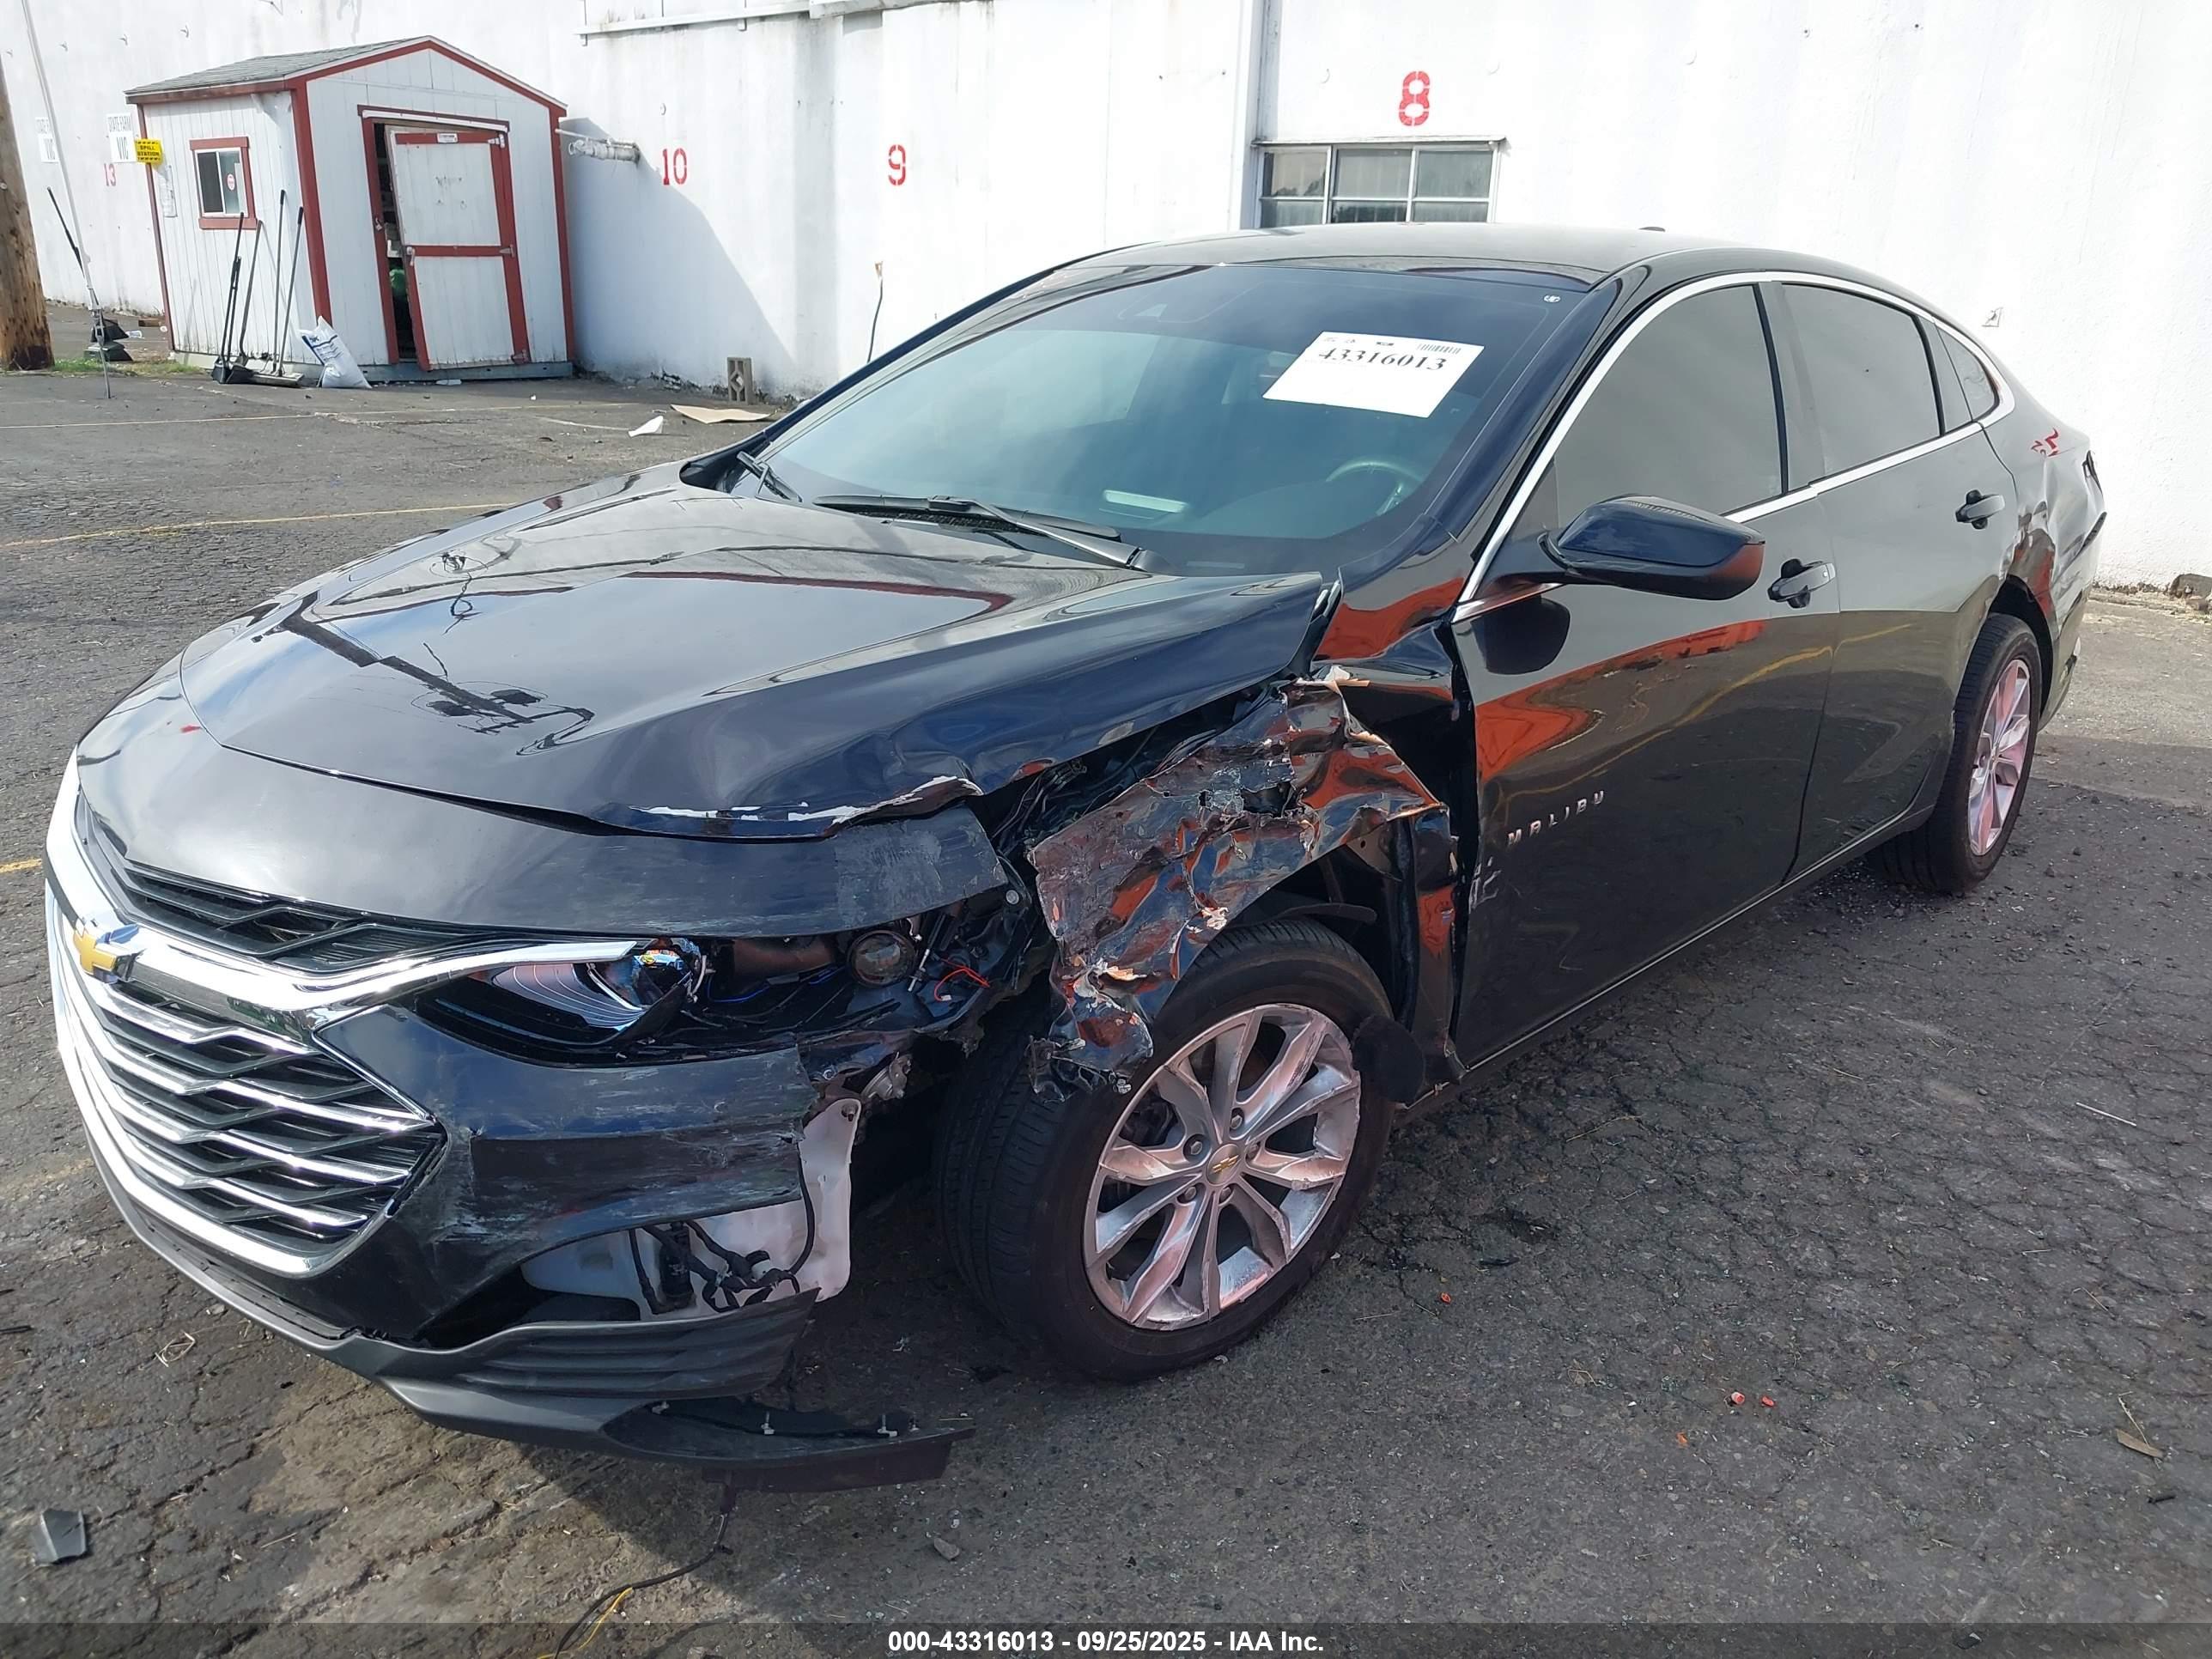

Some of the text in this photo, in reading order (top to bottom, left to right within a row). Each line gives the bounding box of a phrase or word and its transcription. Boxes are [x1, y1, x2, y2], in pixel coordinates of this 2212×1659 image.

[1399, 70, 1430, 126] 8
[104, 163, 117, 186] 13
[662, 148, 687, 185] 10
[888, 144, 906, 185] 9
[1319, 348, 1447, 370] 43316013
[1507, 790, 1604, 846] MALIBU
